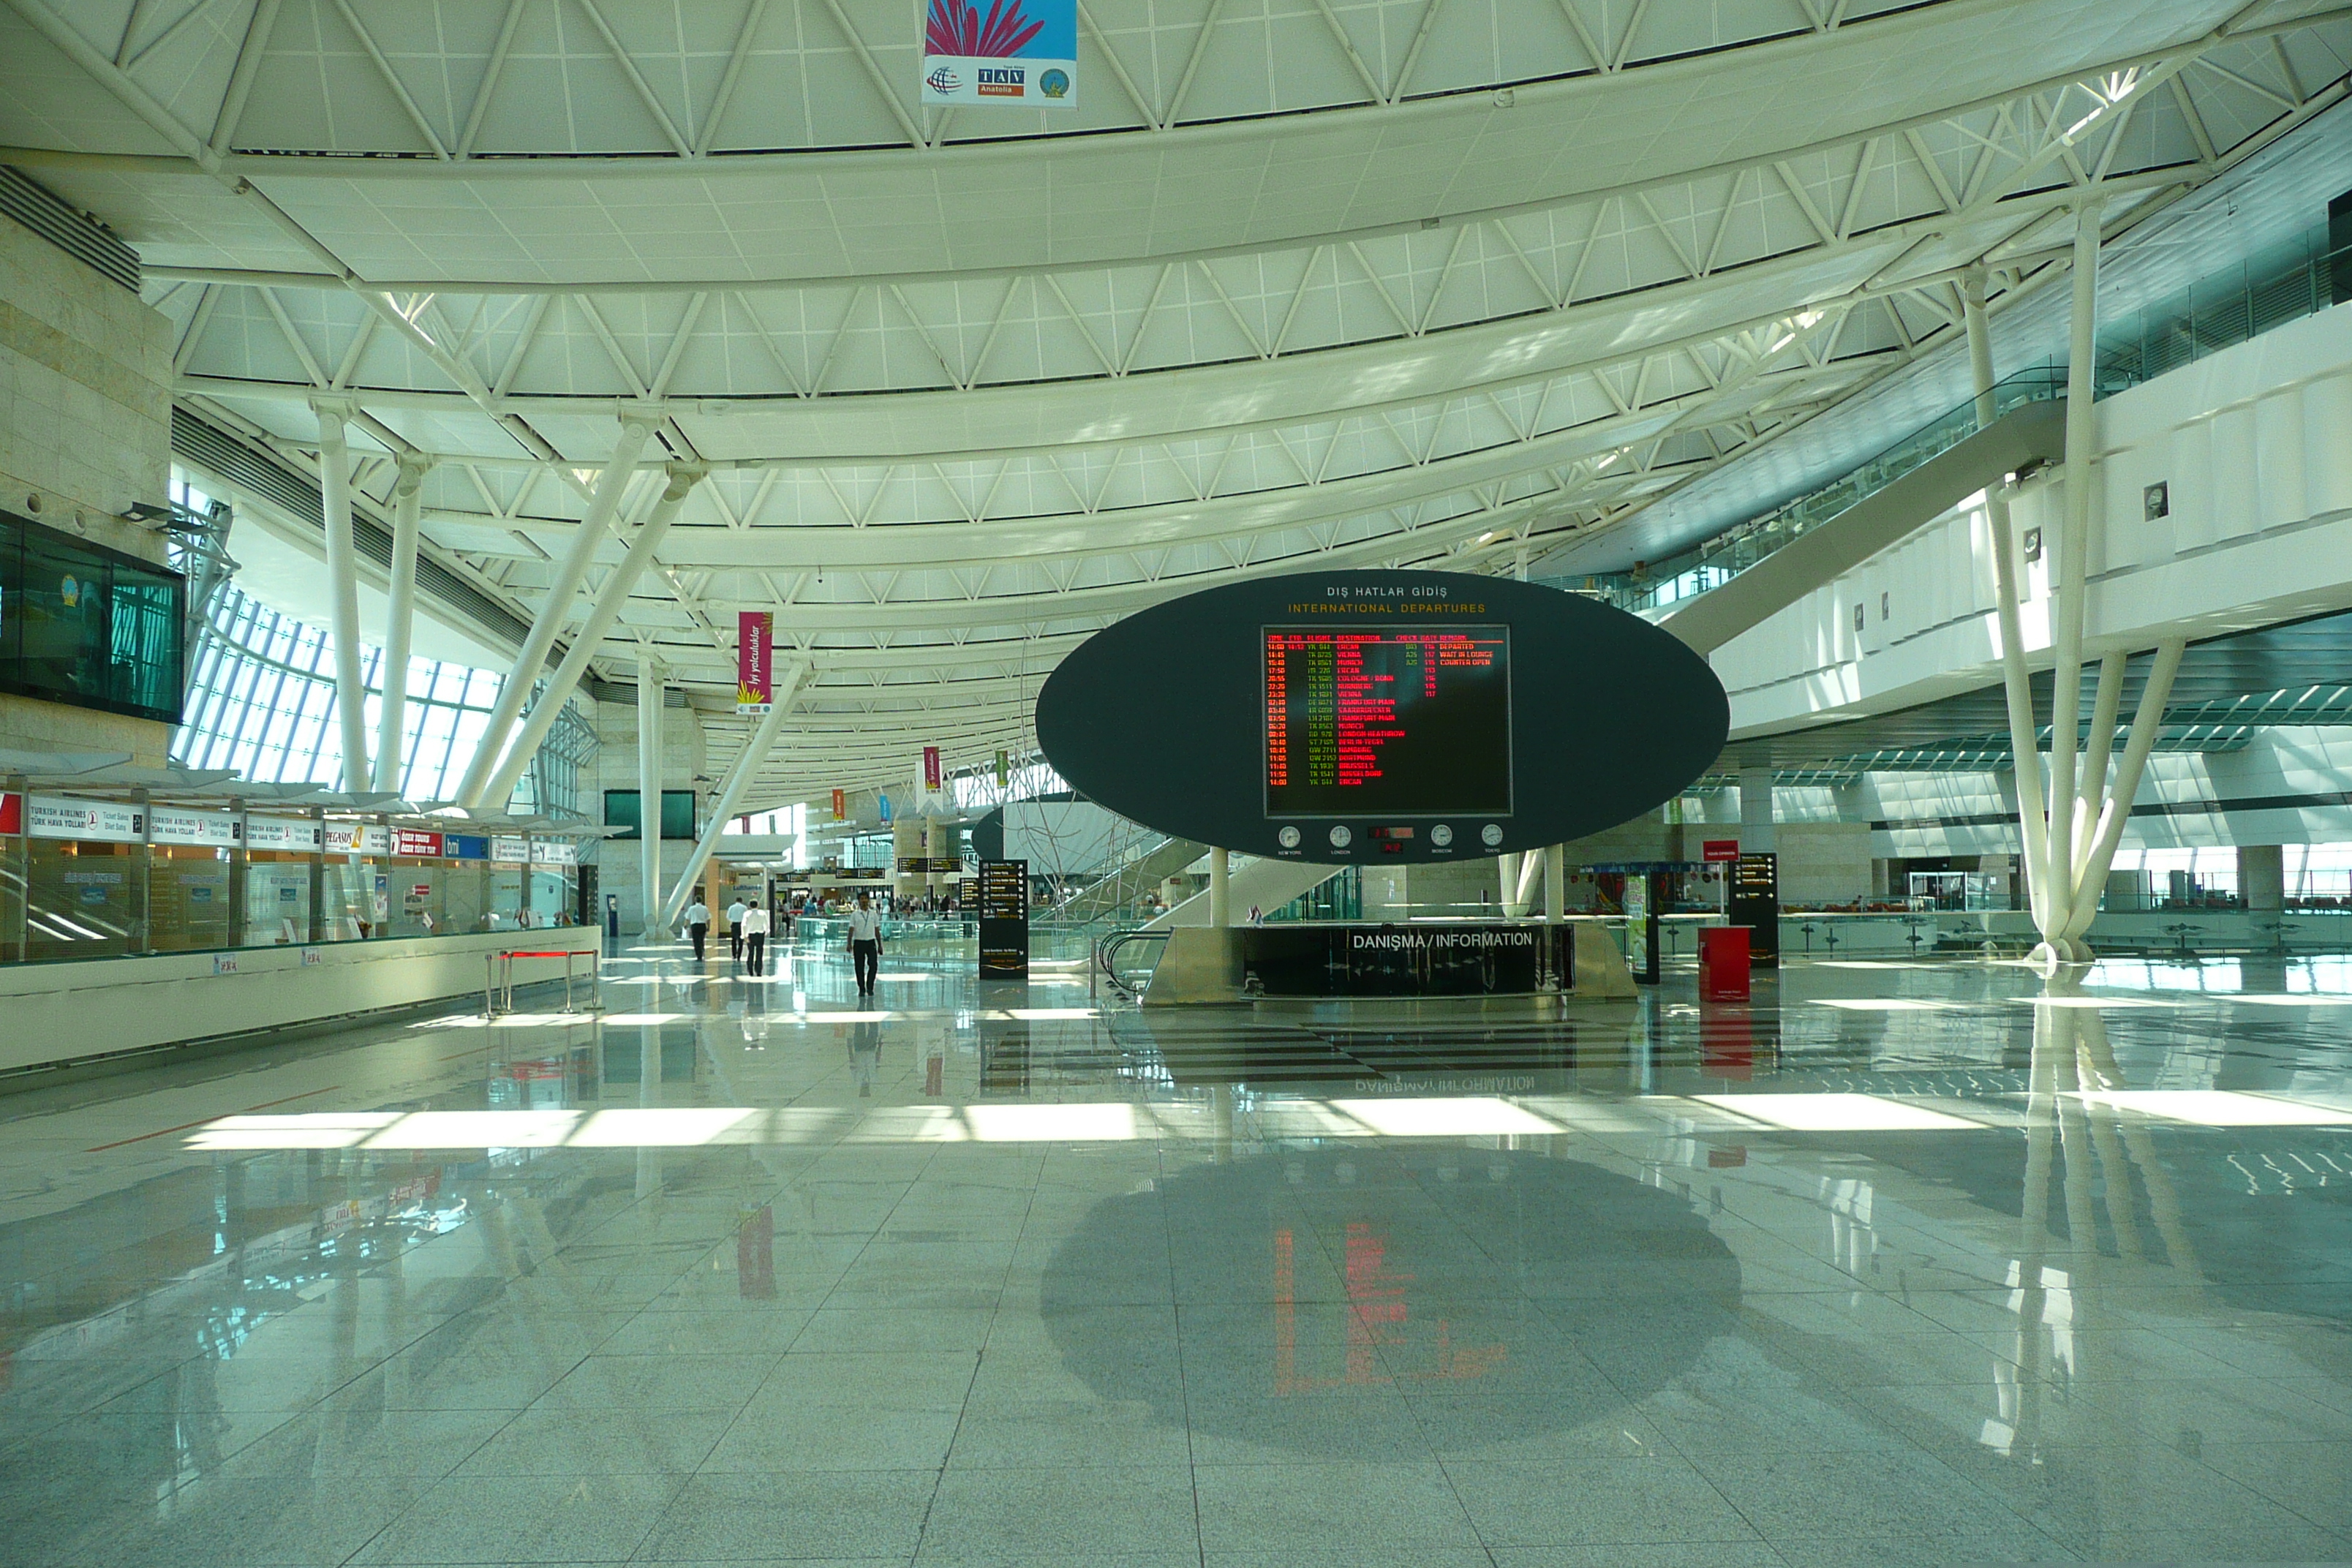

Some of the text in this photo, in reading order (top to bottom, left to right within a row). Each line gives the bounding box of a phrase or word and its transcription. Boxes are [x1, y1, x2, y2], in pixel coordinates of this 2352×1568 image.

[980, 71, 1022, 82] TAV
[981, 86, 1012, 94] Anatolia
[1327, 585, 1447, 598] DIŞ HATLAR GİDİŞ
[1288, 604, 1485, 614] INTERNATIONAL DEPARTURES
[749, 625, 761, 685] İyi yolculuklar
[31, 807, 86, 818] TURKISH AIRLINES
[31, 815, 86, 829] TÜRK HAVA YOLLARI
[152, 815, 195, 826] TURKISH AIRLINES
[165, 826, 177, 834] HAVA
[325, 831, 353, 844] PEGASUS
[447, 837, 459, 855] bmi
